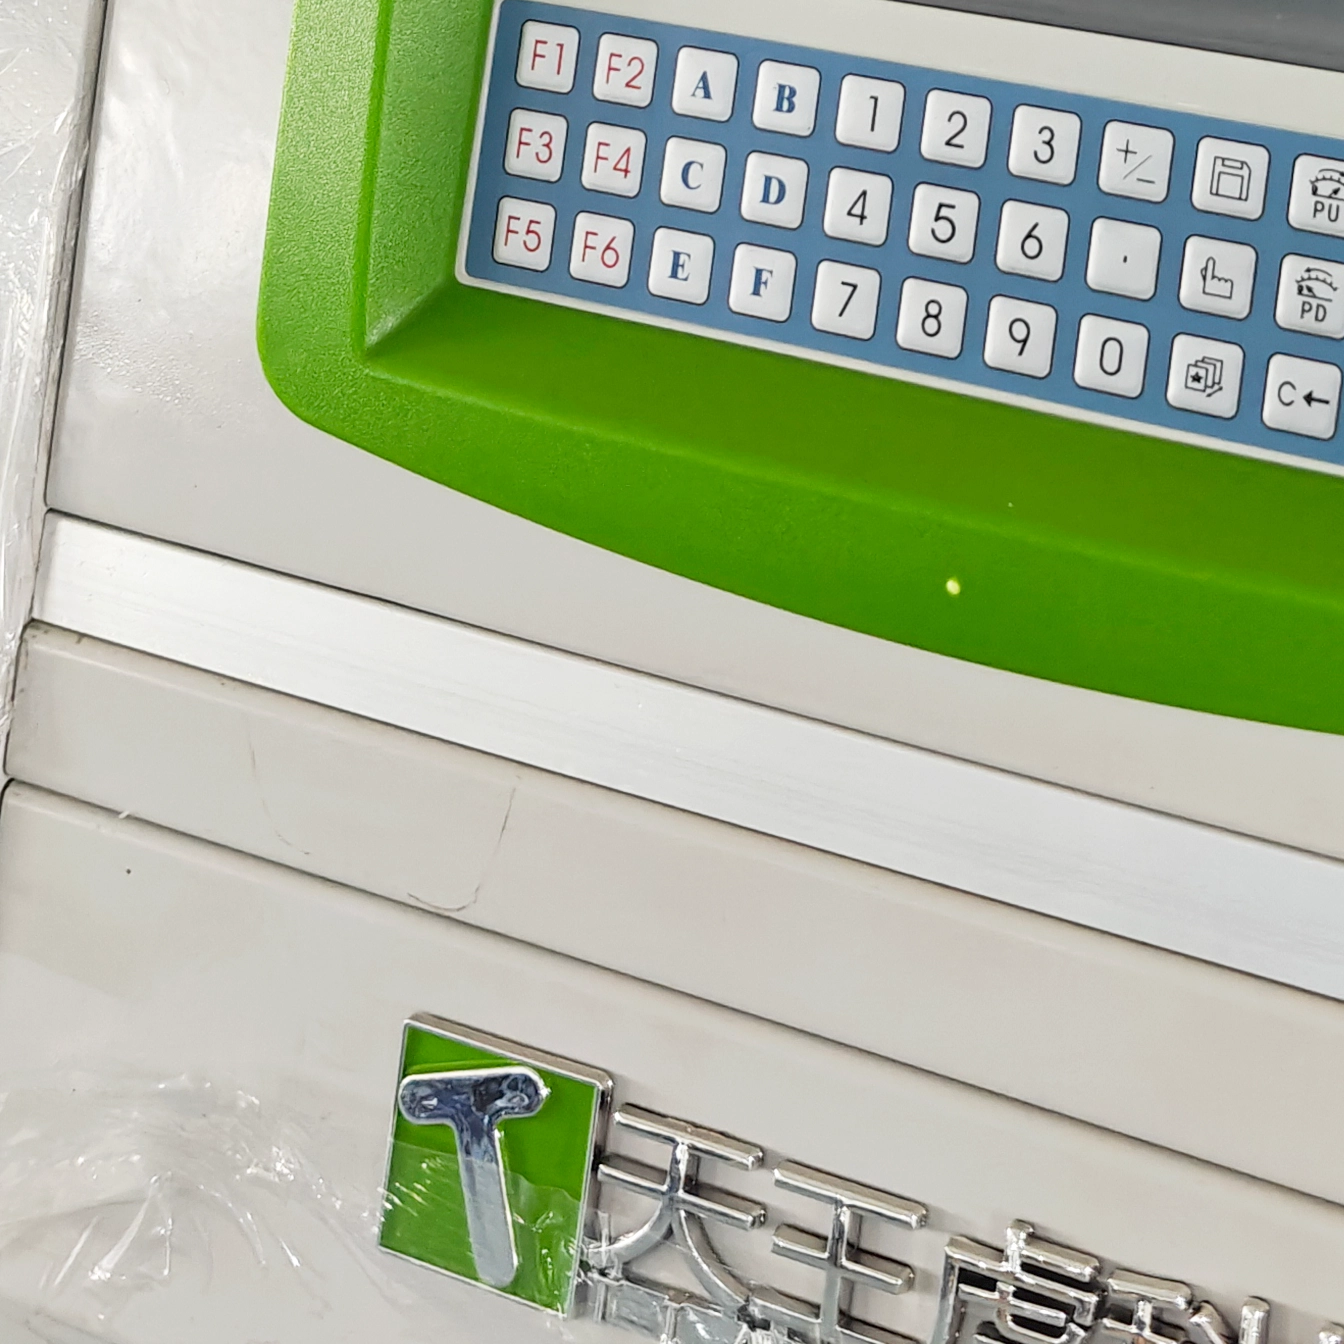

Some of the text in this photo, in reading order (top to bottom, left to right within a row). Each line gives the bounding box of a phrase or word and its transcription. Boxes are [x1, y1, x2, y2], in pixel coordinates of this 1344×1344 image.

[530, 38, 565, 76] F1
[604, 52, 646, 90] F2
[690, 70, 713, 100] A
[773, 83, 797, 114] B
[867, 95, 879, 133] 1
[944, 110, 969, 150] 2
[515, 126, 553, 164] F3
[593, 141, 632, 179] F4
[1033, 125, 1055, 165] 3
[680, 160, 704, 190] C
[759, 174, 787, 206] D
[846, 189, 868, 226] 4
[930, 202, 957, 244] 5
[1312, 200, 1340, 223] PU
[503, 214, 542, 253] F5
[581, 229, 620, 269] F6
[1020, 222, 1044, 261] 6
[668, 250, 691, 282] E
[750, 267, 774, 297] F
[838, 280, 859, 319] 7
[1299, 303, 1328, 324] PD
[920, 299, 943, 339] 8
[1008, 317, 1031, 357] 9
[1099, 336, 1124, 377] 0
